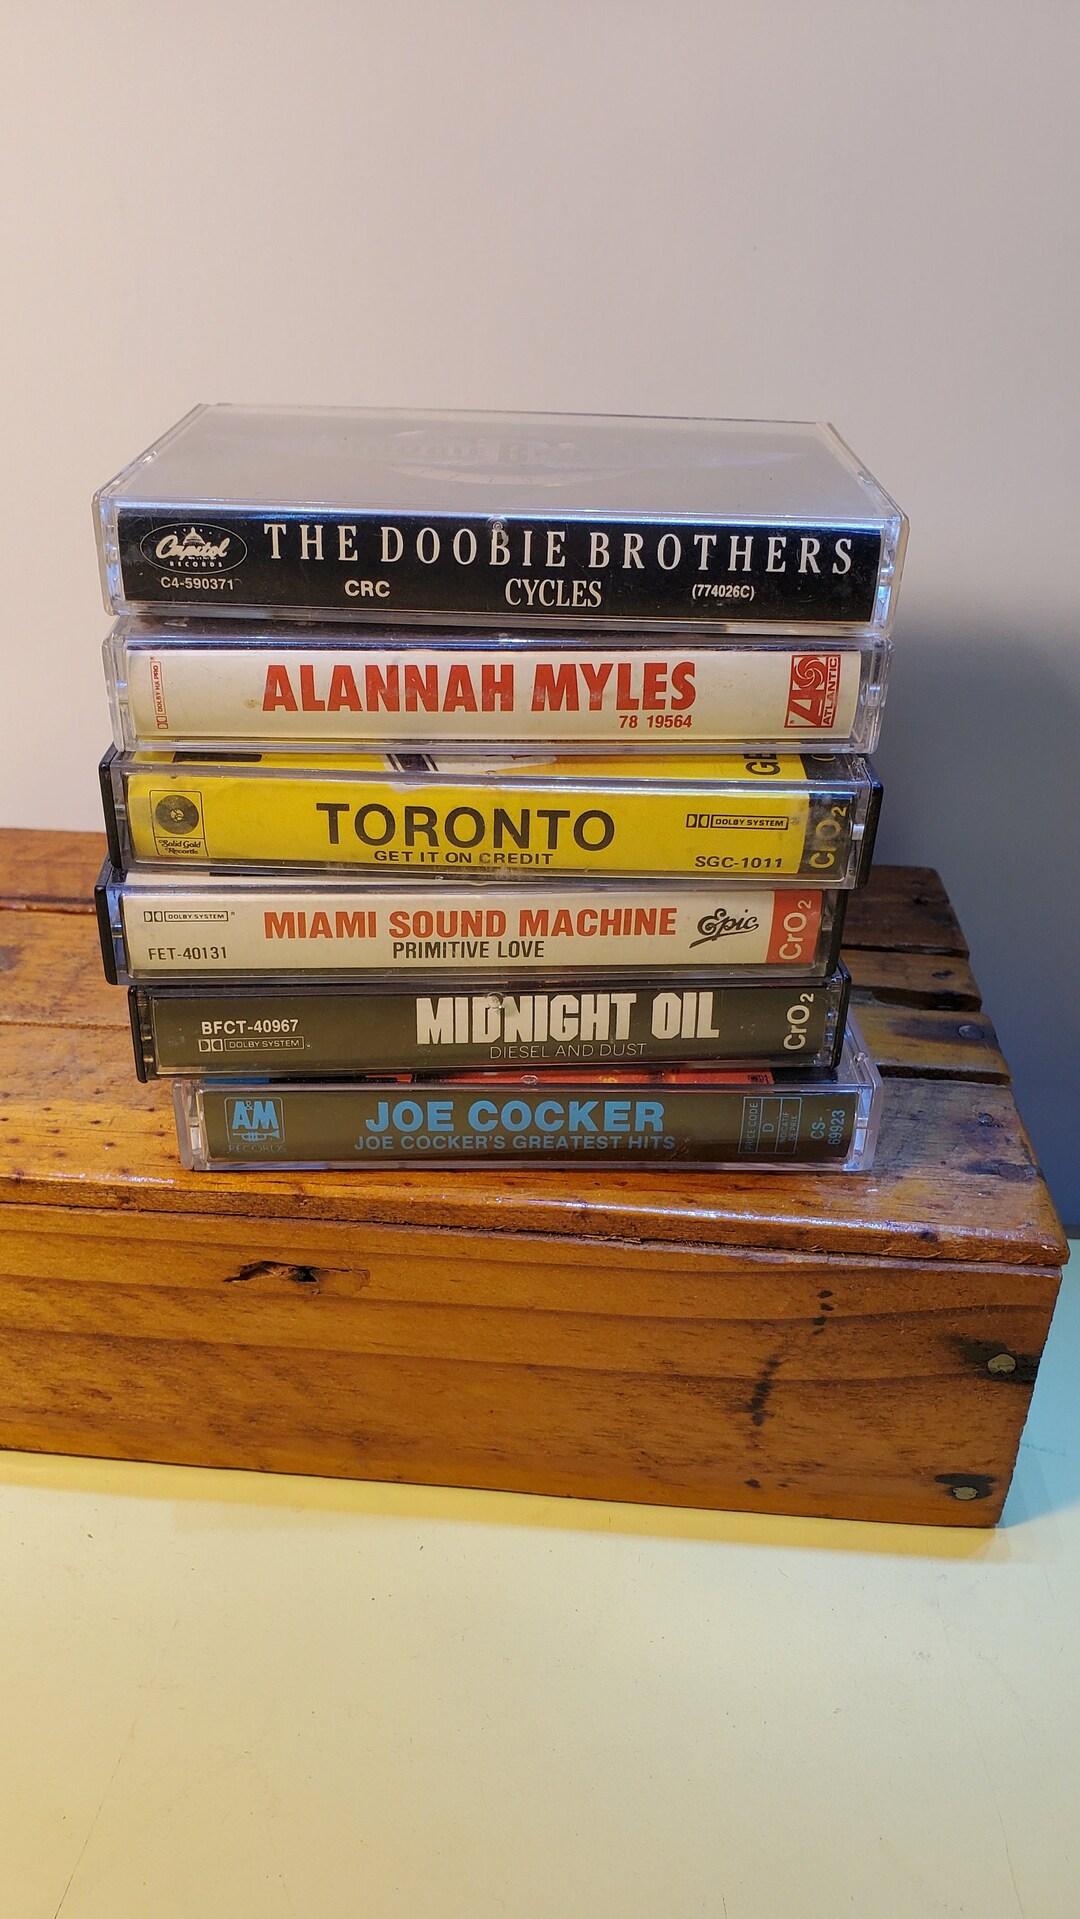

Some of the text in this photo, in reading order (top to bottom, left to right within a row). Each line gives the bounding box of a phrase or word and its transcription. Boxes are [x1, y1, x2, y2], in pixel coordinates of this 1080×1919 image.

[156, 532, 230, 560] Capitol
[263, 523, 853, 575] THE DOOBIE BROTHERS
[169, 560, 223, 568] RECORDS
[160, 576, 234, 591] C4-590371
[344, 579, 390, 598] CRC
[504, 577, 602, 608] CYCLES
[691, 584, 755, 601] (774026C)
[262, 661, 696, 713] ALANNAH MYLES
[822, 657, 837, 725] ATLANTIC
[618, 714, 693, 729] 78 19564
[316, 802, 615, 851] TORONTO
[715, 818, 785, 827] DOLBY SYSTEM
[158, 839, 202, 849] Solid Gold
[374, 850, 554, 866] GET IT ON CREDIT
[694, 855, 783, 869] SGC-1011
[264, 907, 677, 939] MIAMI SOUND MACHINE
[689, 907, 760, 948] Epic
[147, 946, 227, 961] FET-40131
[392, 940, 545, 960] PRIMITIVE LOVE
[201, 1018, 299, 1035] BFCT-40967
[416, 991, 720, 1046] MIDNIGHT OIL
[229, 1039, 300, 1049] DOLBY SYSTEM
[489, 1042, 647, 1060] DIESEL AND DUST
[231, 1100, 280, 1130] A&M
[365, 1100, 665, 1133] JOE COCKER
[744, 1102, 759, 1150] PRICE CODE
[762, 1123, 775, 1132] D
[828, 1109, 846, 1146] 69923
[354, 1134, 676, 1151] JOE COCKER'S GREATEST HITS
